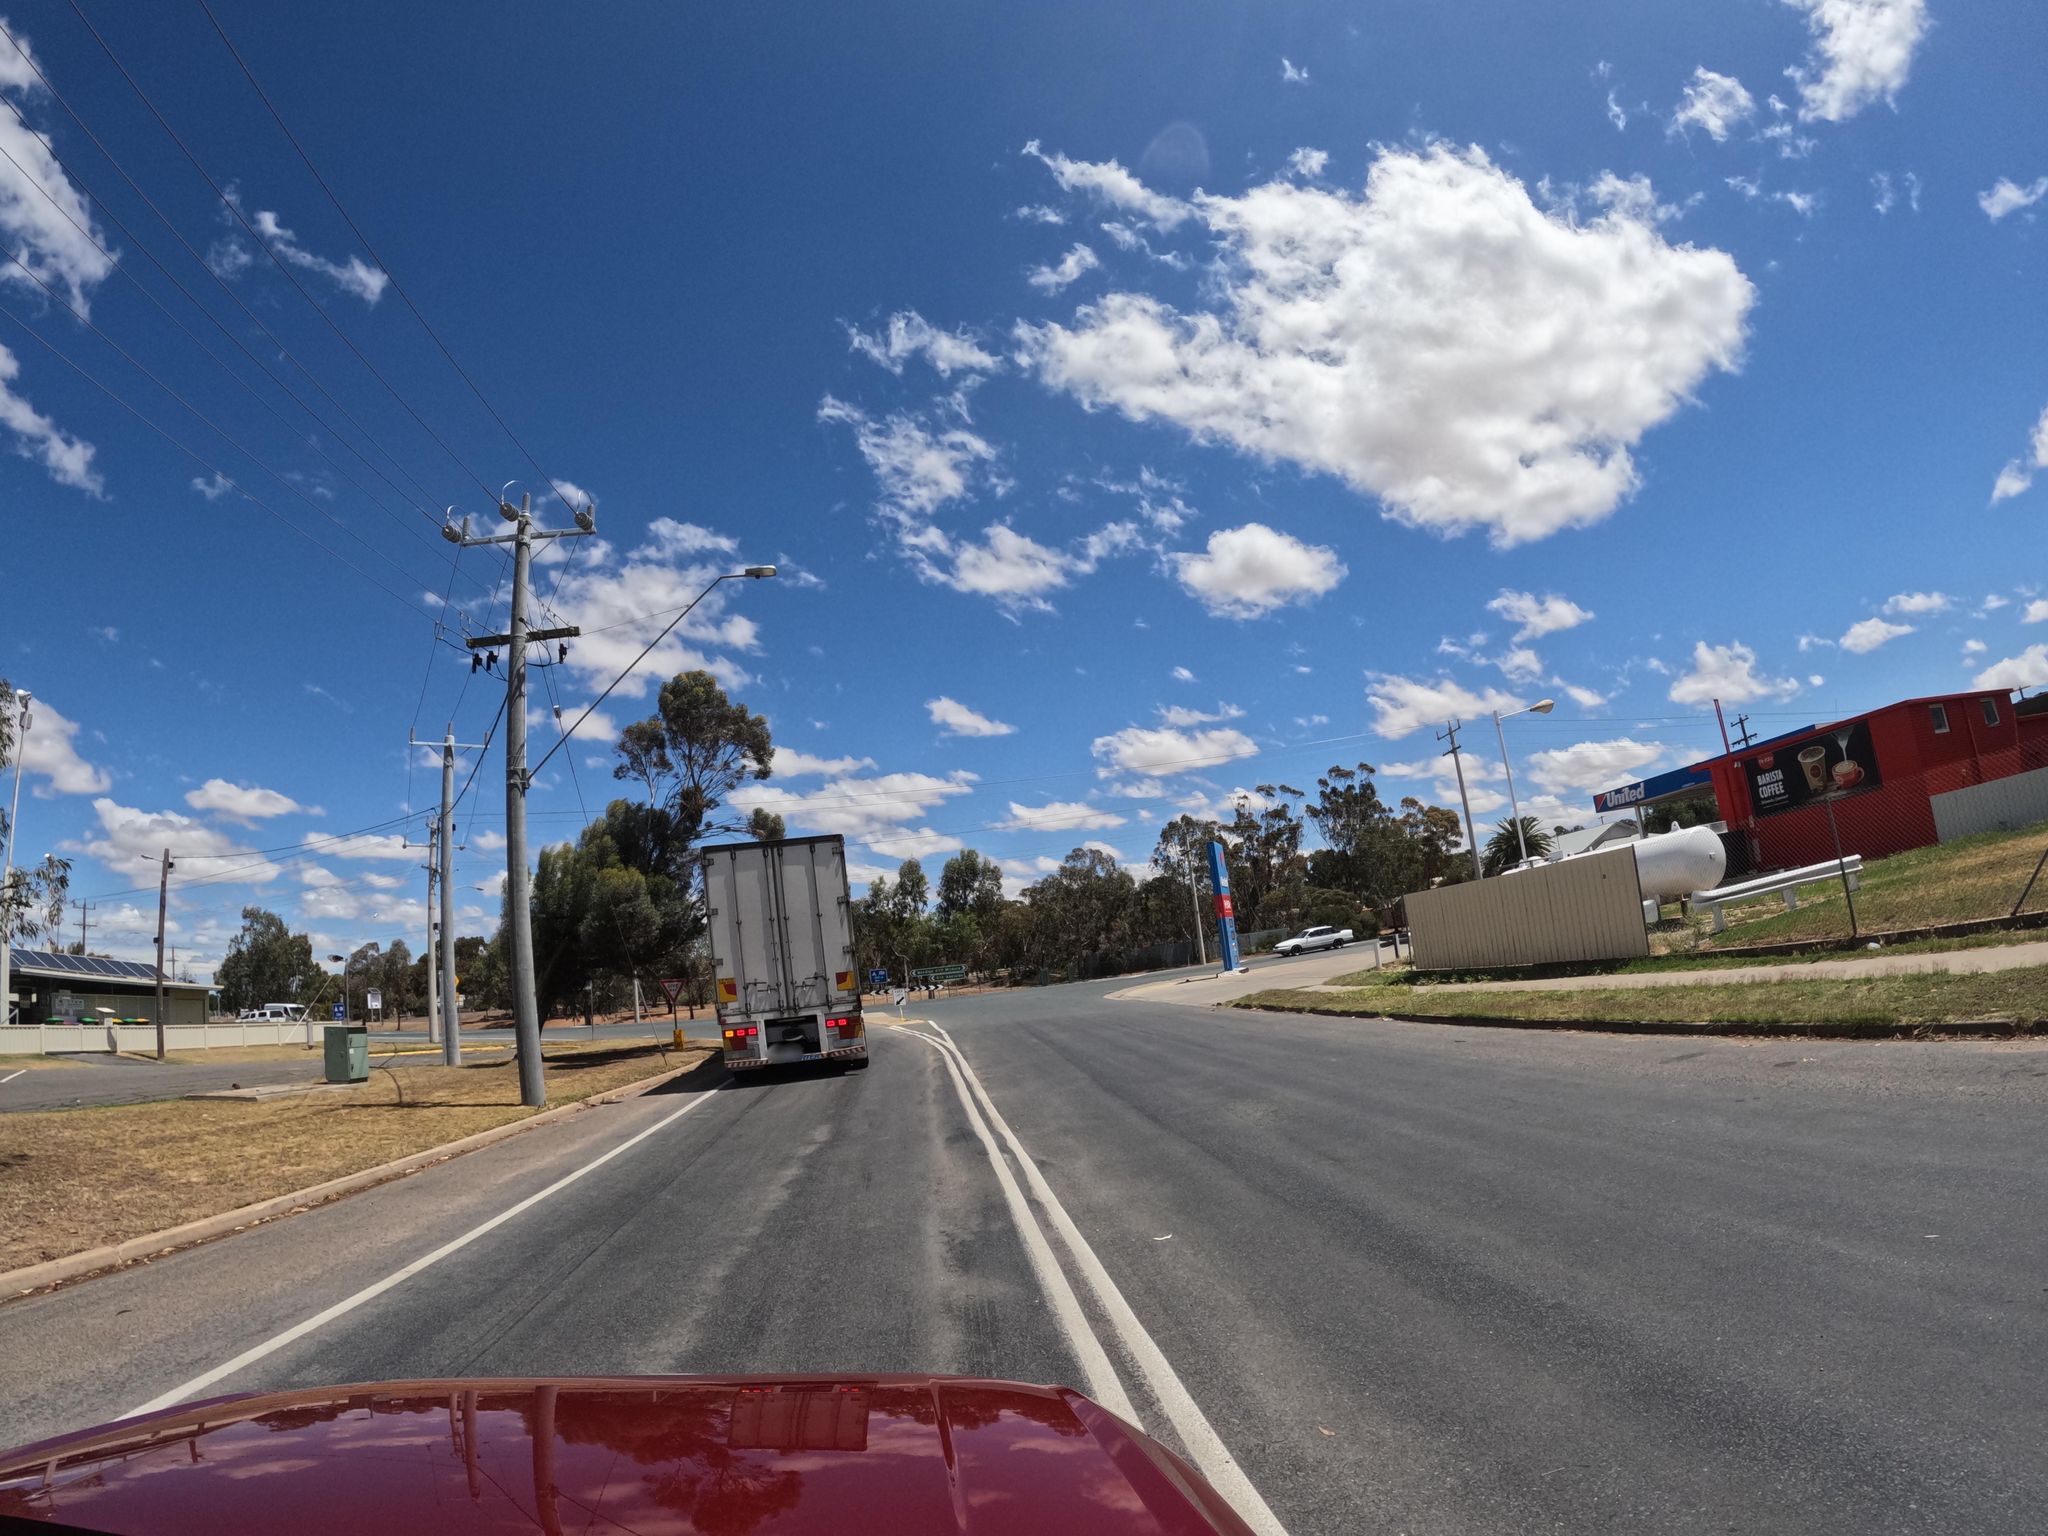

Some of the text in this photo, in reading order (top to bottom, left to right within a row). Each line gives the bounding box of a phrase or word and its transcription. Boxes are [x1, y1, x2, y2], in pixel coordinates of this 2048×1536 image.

[1757, 769, 1784, 786] BARISTA
[1605, 782, 1645, 808] United
[1759, 781, 1785, 799] COFFEE
